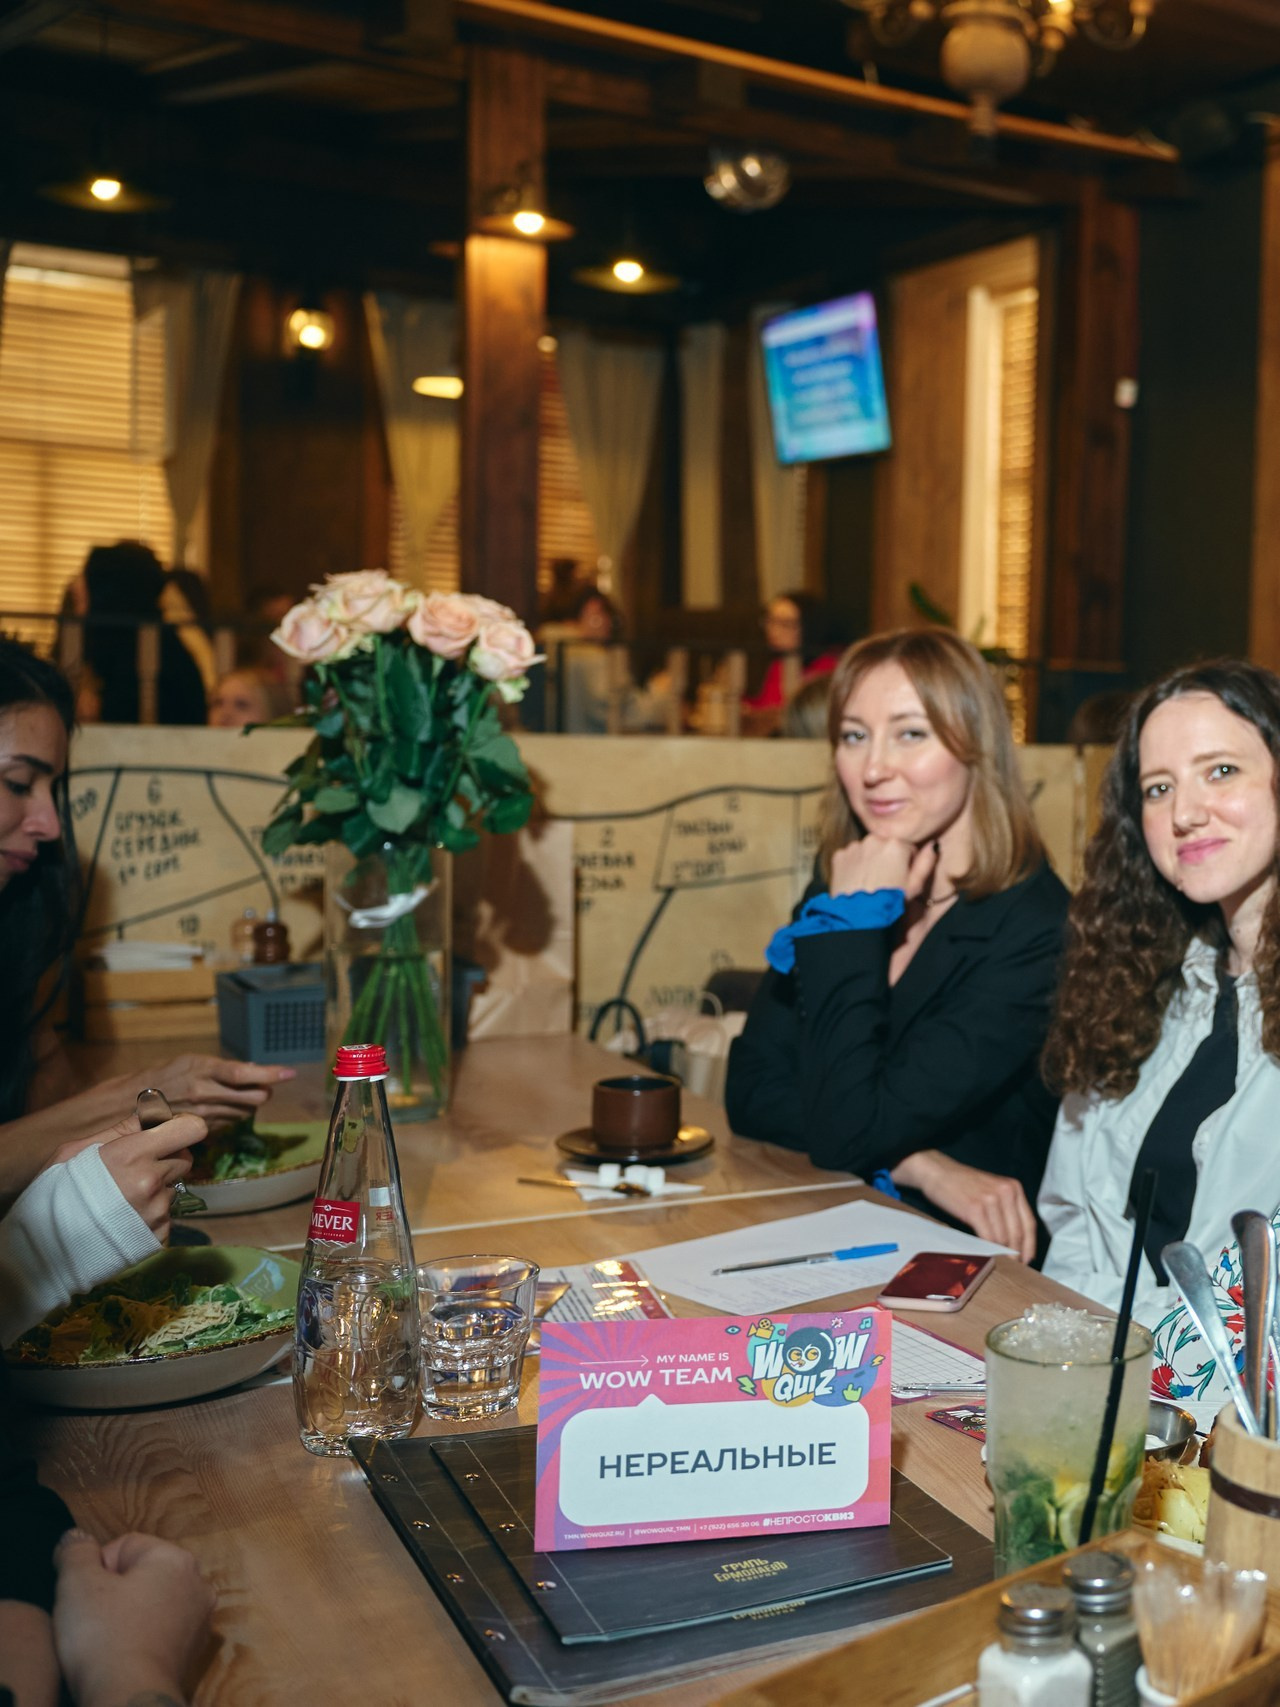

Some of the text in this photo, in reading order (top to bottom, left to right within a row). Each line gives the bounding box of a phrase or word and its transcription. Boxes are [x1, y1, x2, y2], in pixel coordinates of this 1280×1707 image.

[656, 1352, 730, 1364] MY NAME IS
[579, 1366, 733, 1390] WOW TEAM
[774, 1368, 836, 1403] QUIZ
[599, 1442, 837, 1480] НЕРЕАЛЬНЫЕ
[763, 1511, 855, 1527] #НЕПРОСТОКВИЗ
